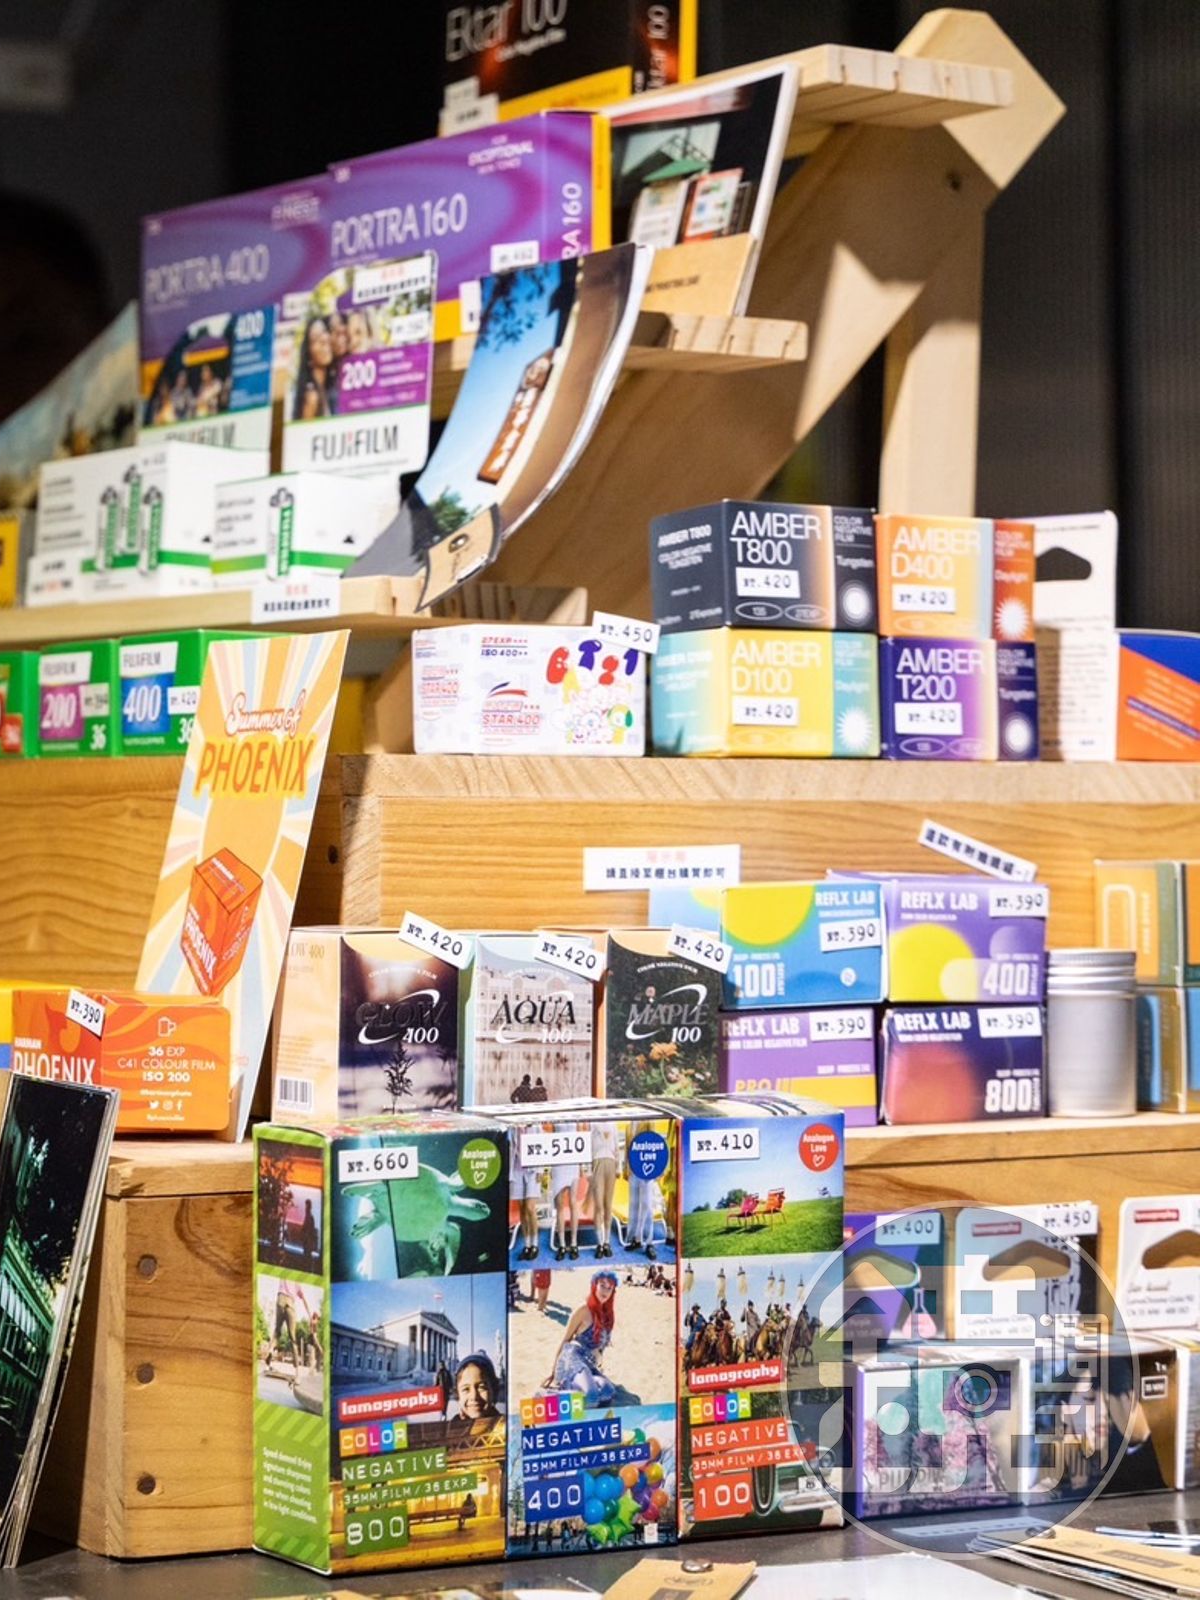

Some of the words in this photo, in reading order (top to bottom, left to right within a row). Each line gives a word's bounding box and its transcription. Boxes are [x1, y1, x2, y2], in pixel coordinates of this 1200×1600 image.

[446, 2, 512, 61] Ektar
[520, 0, 567, 34] 100
[562, 183, 583, 220] 160
[330, 205, 419, 258] PORTRA
[422, 193, 468, 237] 160
[146, 257, 224, 300] PORTRA
[225, 244, 270, 286] 400
[342, 360, 377, 390] 200
[311, 425, 399, 461] FUJIFILM
[730, 510, 823, 540] AMBER
[729, 537, 793, 566] T800
[893, 525, 982, 555] AMBER
[891, 551, 956, 580] D400
[123, 651, 162, 669] FUJIFILM
[481, 648, 497, 656] ISO
[731, 639, 823, 668] AMBER
[896, 648, 984, 674] AMBER
[732, 667, 793, 694] D100
[895, 674, 957, 700] T200
[41, 693, 78, 729] 200
[123, 685, 162, 722] 400
[224, 691, 284, 737] Summer
[284, 688, 307, 740] of
[90, 724, 107, 750] 36
[195, 739, 314, 794] PHOENIX
[814, 890, 850, 907] REFLX
[853, 888, 876, 905] LAB
[901, 889, 946, 911] REFLX
[950, 890, 979, 911] LAB
[407, 922, 464, 957] NT.420
[673, 933, 725, 963] NT.420
[542, 940, 597, 971] NT.420
[732, 962, 777, 999] 100
[982, 962, 1031, 996] 400
[355, 1000, 449, 1029] GLOW
[490, 999, 577, 1027] AQUA
[627, 1003, 709, 1026] MAPLE
[721, 1016, 768, 1038] REFLX
[771, 1014, 802, 1036] LAB
[893, 1010, 940, 1031] REFLX
[941, 1009, 972, 1031] LAB
[402, 1027, 440, 1044] 400
[540, 1027, 573, 1044] 100
[671, 1026, 702, 1044] 100
[117, 1057, 138, 1069] C41
[141, 1058, 189, 1070] COLOUR
[191, 1059, 217, 1071] FILM
[148, 1045, 164, 1057] 36
[166, 1046, 186, 1057] EXP
[13, 1050, 97, 1086] PHOENIX
[142, 1071, 164, 1082] ISO
[167, 1071, 191, 1082] 200
[984, 1076, 1034, 1114] 800
[527, 1136, 585, 1157] NT.510
[631, 1140, 665, 1153] Analogue
[696, 1133, 754, 1152] NT.410
[802, 1132, 835, 1146] Analogue
[810, 1143, 828, 1154] Love
[347, 1152, 410, 1174] NT.660
[470, 1160, 489, 1171] Love
[639, 1152, 657, 1162] Love
[521, 1400, 584, 1421] COLOR
[690, 1397, 750, 1419] COLOR
[341, 1428, 407, 1450] COLOR
[522, 1423, 620, 1451] NEGATIVE
[692, 1422, 786, 1448] NEGATIVE
[342, 1452, 446, 1481] NEGATIVE
[523, 1459, 558, 1474] 35MM
[560, 1455, 589, 1469] FILM
[692, 1457, 726, 1471] 35MM
[728, 1454, 755, 1468] FILM
[344, 1490, 379, 1505] 35MM
[381, 1486, 410, 1500] FILM
[527, 1484, 582, 1510] 400
[698, 1482, 751, 1509] 100
[346, 1516, 405, 1546] 800
